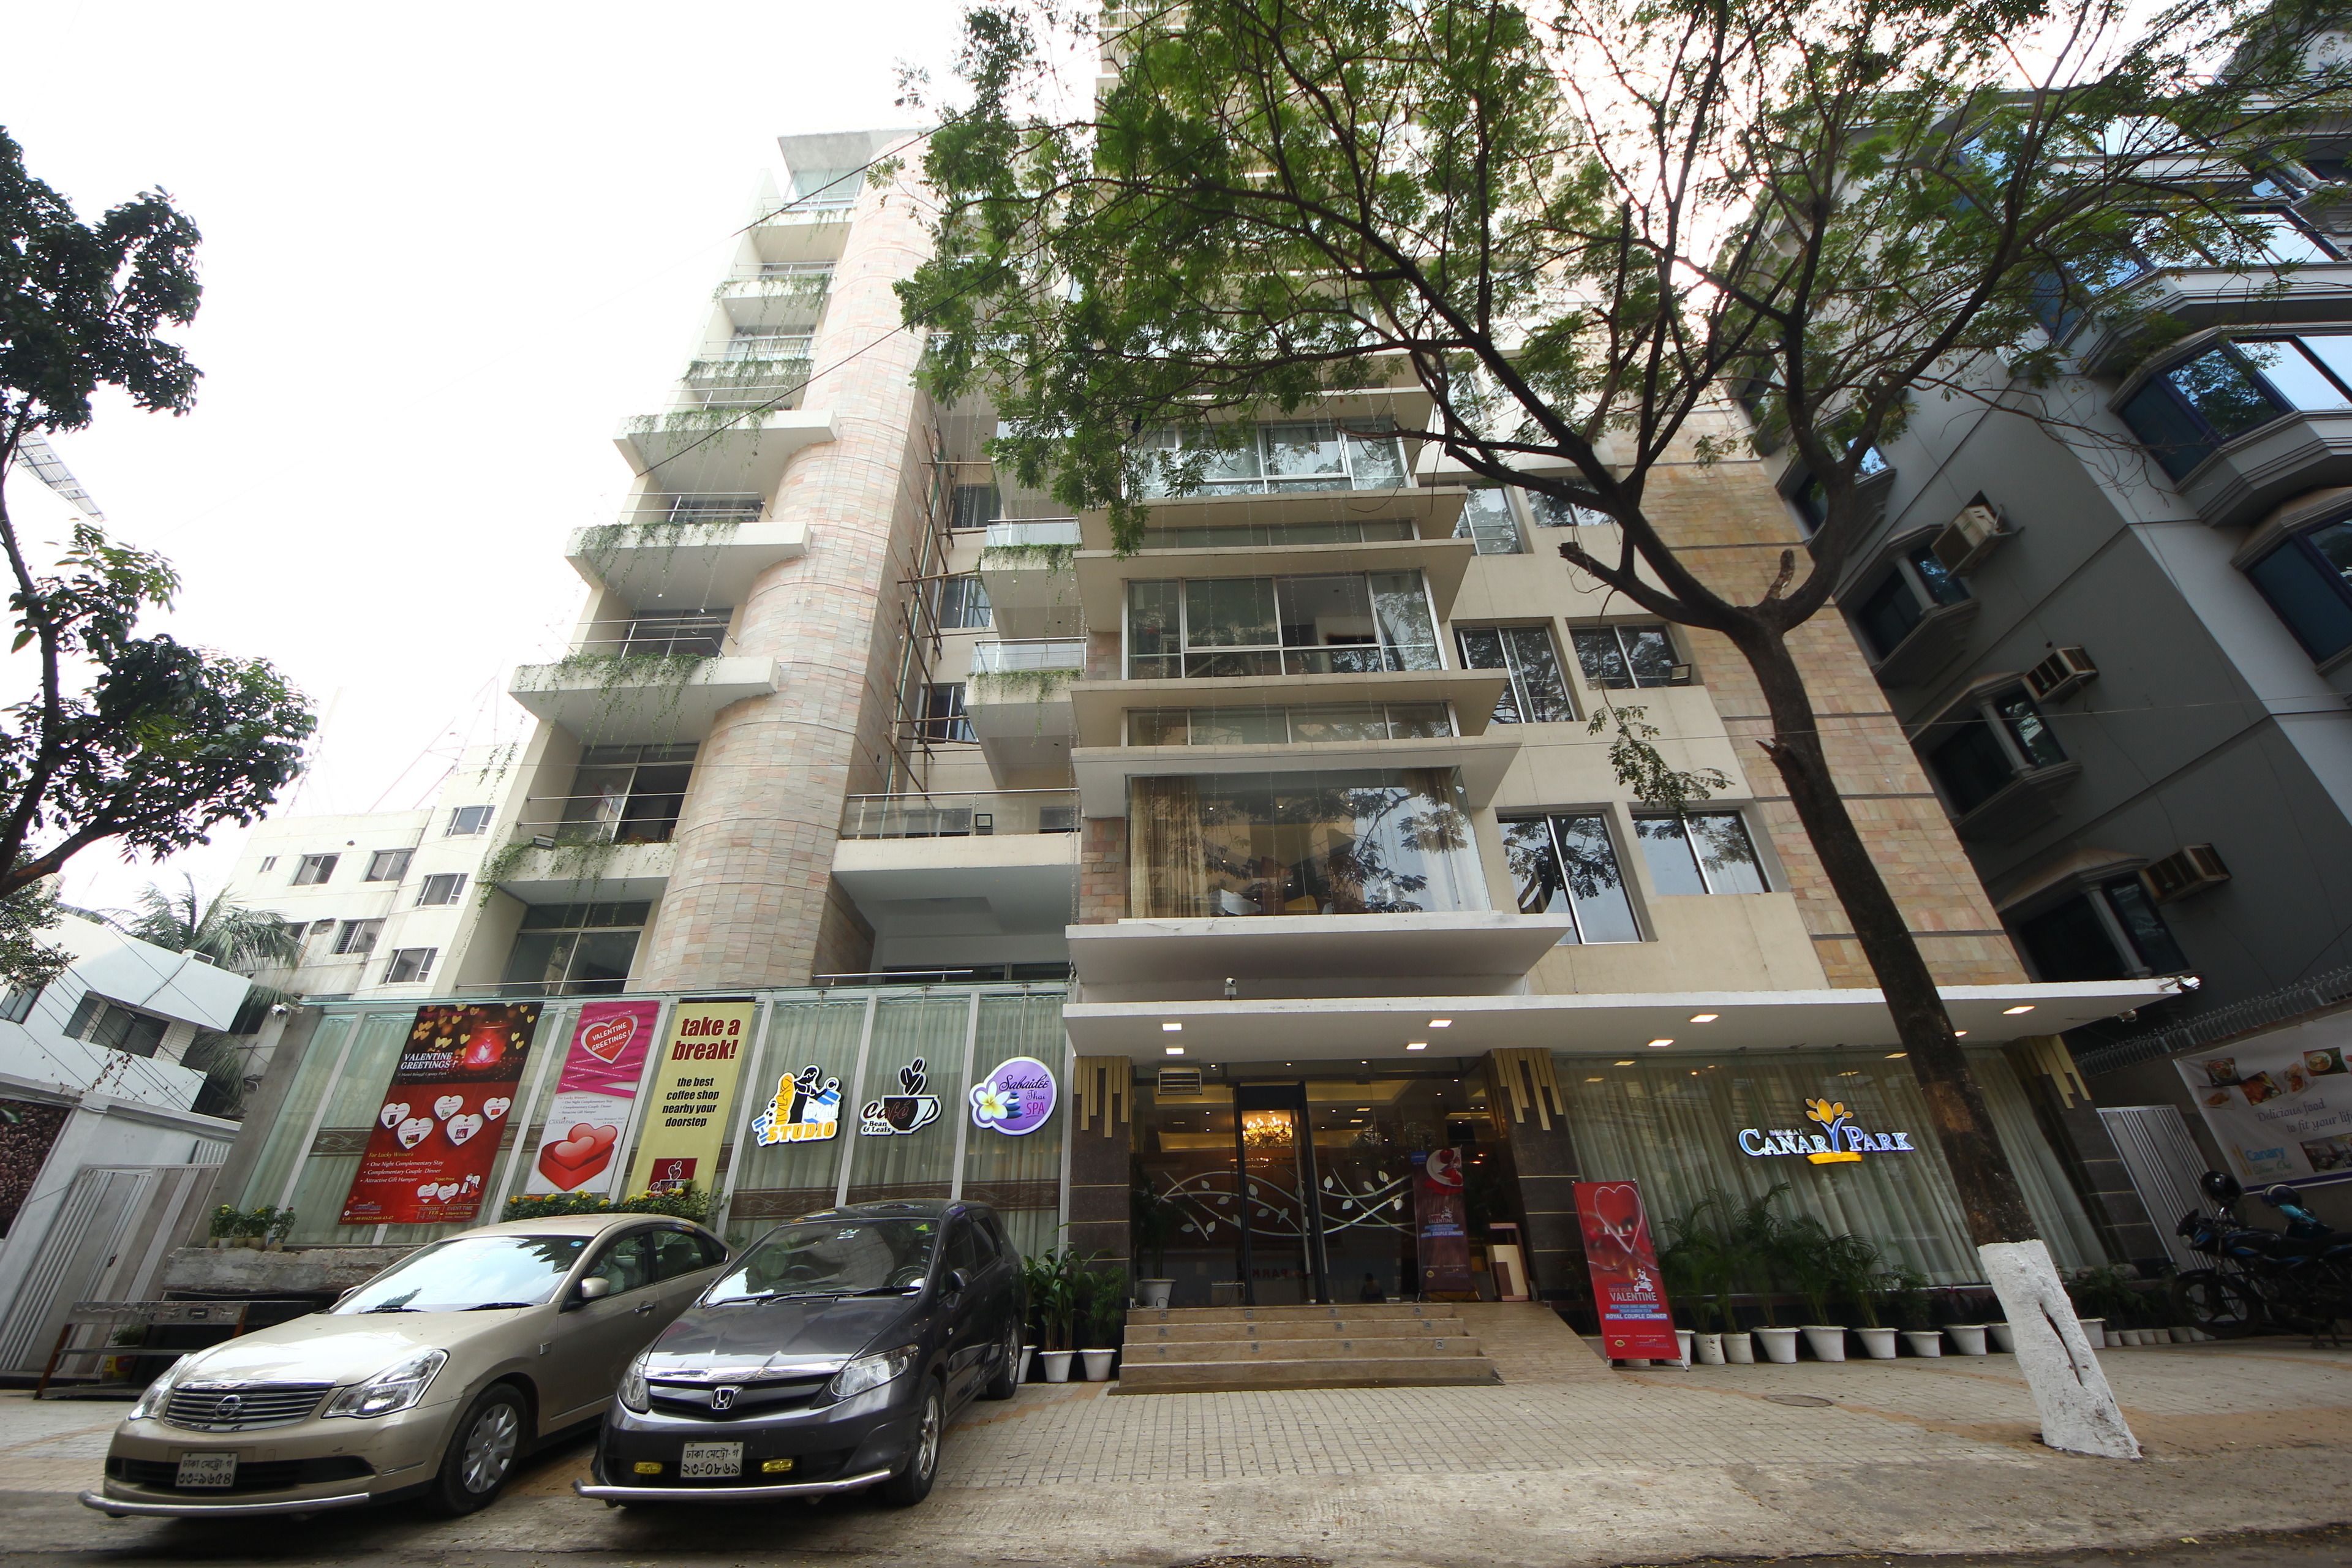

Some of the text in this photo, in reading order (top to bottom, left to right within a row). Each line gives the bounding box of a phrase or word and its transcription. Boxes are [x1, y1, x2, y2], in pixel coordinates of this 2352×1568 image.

[592, 1022, 627, 1041] VALENTINE
[680, 1017, 741, 1036] take a
[592, 1031, 627, 1051] GREETINGS
[671, 1039, 739, 1060] break!
[405, 1052, 453, 1061] VALENTINE
[401, 1060, 451, 1069] GREETINGS
[677, 1077, 714, 1087] the best
[666, 1090, 720, 1101] coffee shop
[1026, 1090, 1045, 1100] Thai
[662, 1104, 717, 1114] nearby your
[804, 1104, 838, 1118] GYM
[863, 1100, 911, 1123] Café
[1026, 1102, 1044, 1115] SPA
[2255, 1098, 2326, 1122] Delicious food
[665, 1117, 707, 1128] doorstep
[2286, 1124, 2296, 1133] to
[2297, 1119, 2310, 1132] fit
[2312, 1117, 2337, 1131] your
[767, 1121, 835, 1141] STUDIO
[1841, 1125, 1915, 1152] PARK
[2245, 1147, 2285, 1161] Canary
[1609, 1292, 1657, 1302] VALENTINE
[686, 1450, 704, 1458] ঢাকা
[183, 1460, 200, 1468] ঢাকা
[683, 1463, 739, 1475] ২৩-০৮৬৯
[178, 1472, 232, 1484] ৩৩-৯৬৫৪
